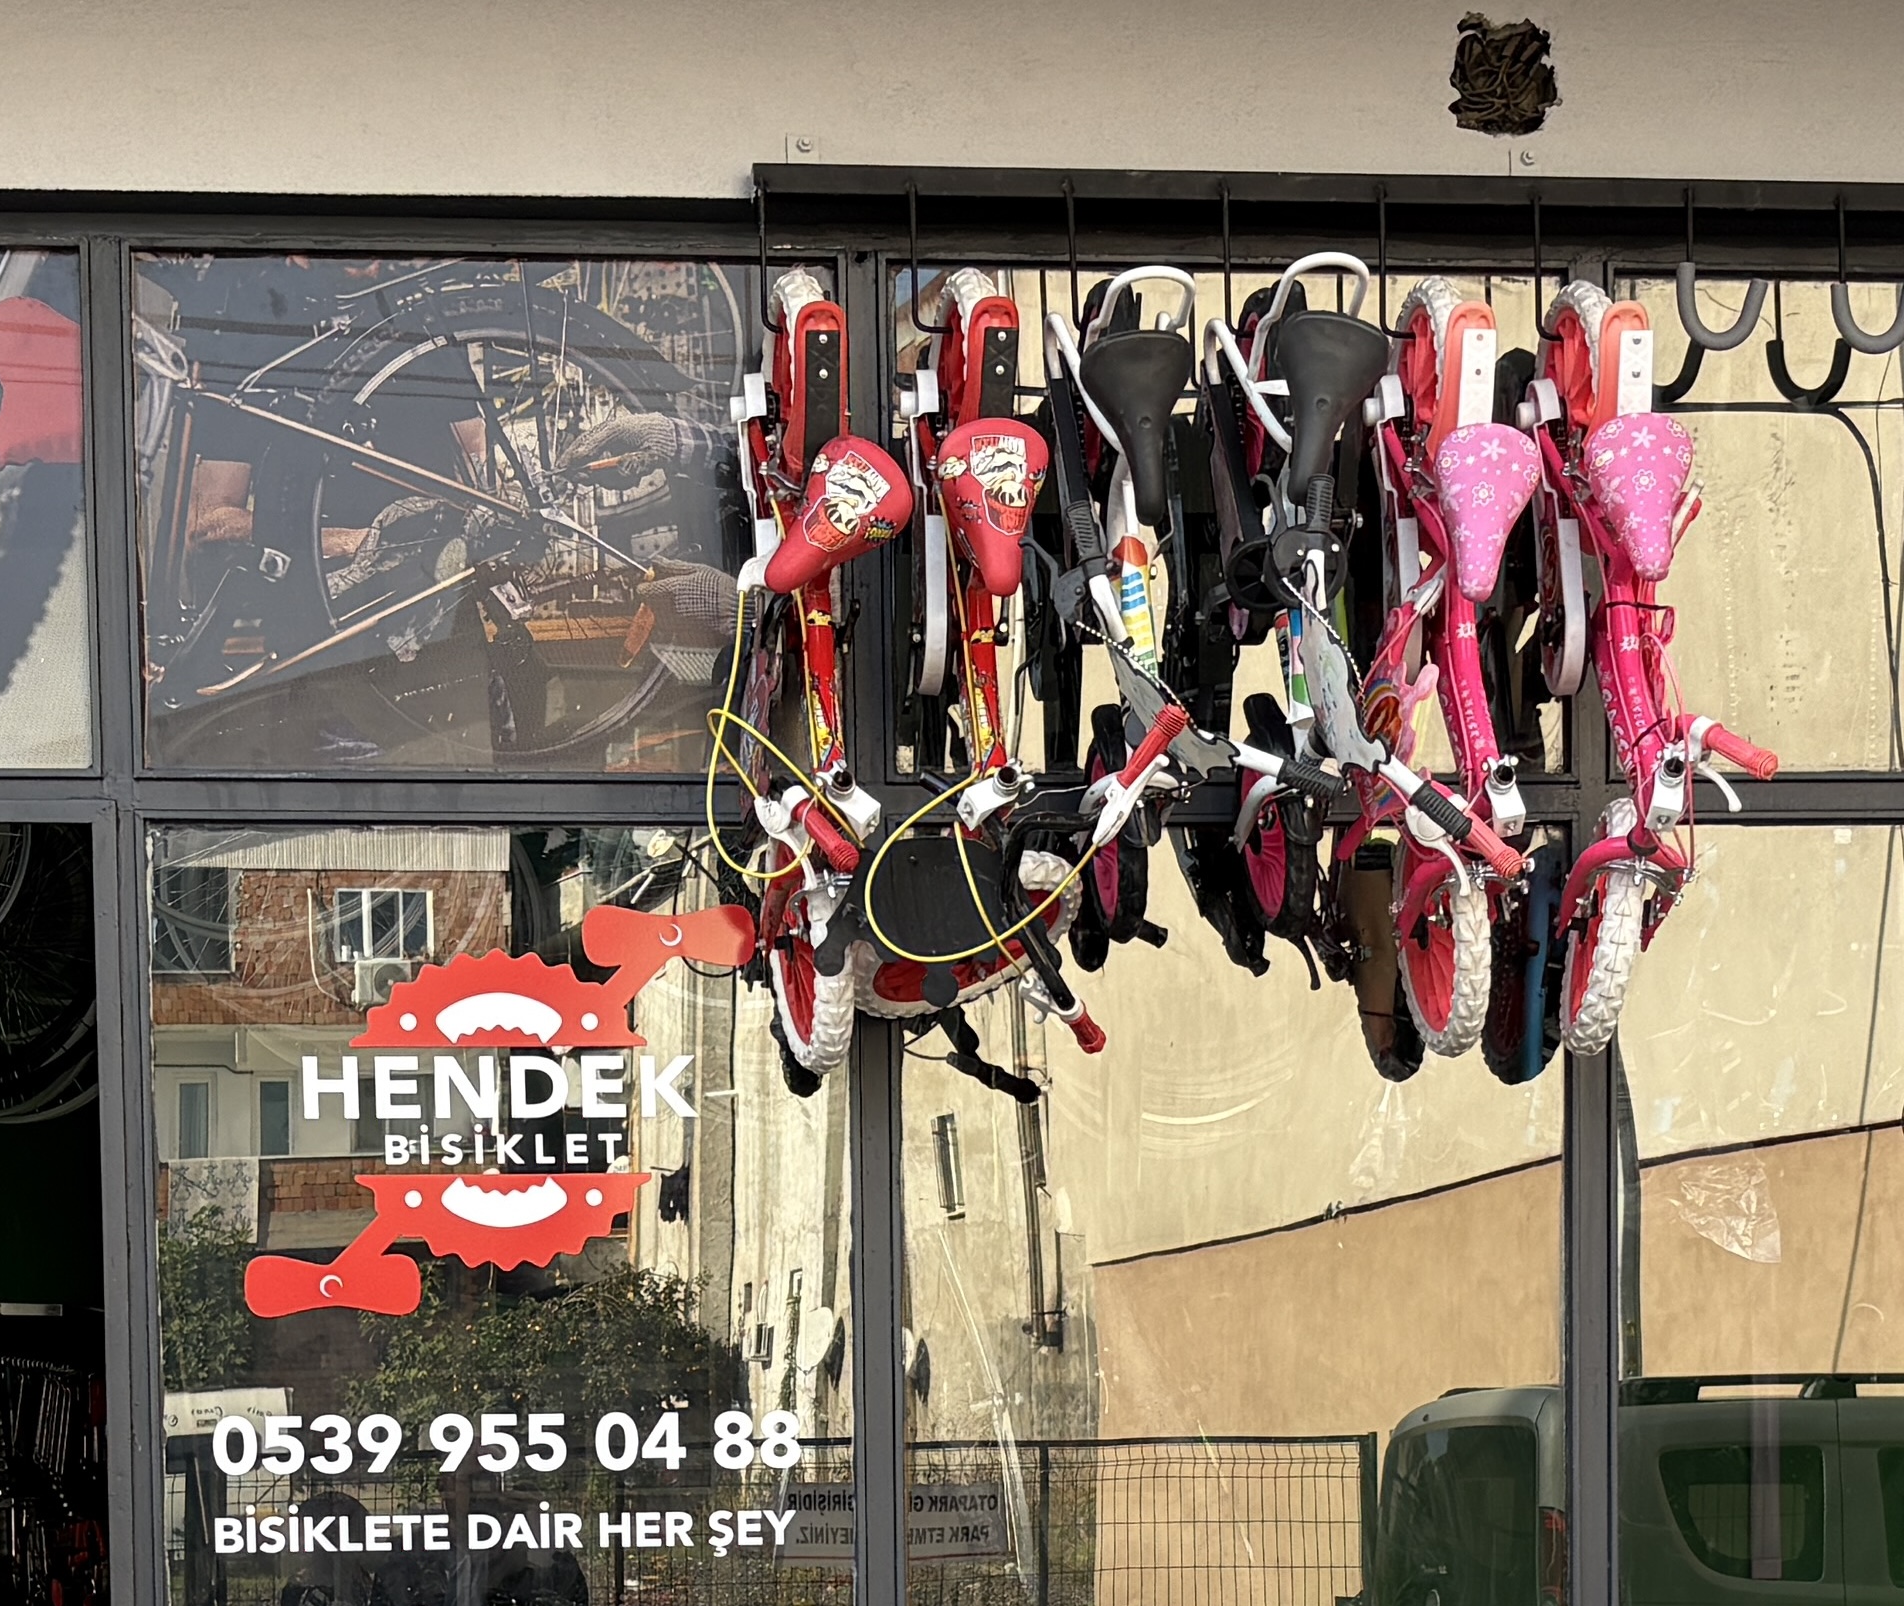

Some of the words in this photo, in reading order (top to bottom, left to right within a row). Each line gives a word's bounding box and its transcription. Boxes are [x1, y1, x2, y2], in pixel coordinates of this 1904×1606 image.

[302, 1055, 697, 1120] HENDEK
[385, 1124, 624, 1165] BİSİKLET
[213, 1414, 402, 1475] 0539
[430, 1412, 566, 1473] 955
[596, 1411, 687, 1470] 04
[713, 1410, 800, 1469] 88
[213, 1504, 451, 1553] BİSİKLETE
[468, 1503, 582, 1549] DAİR
[599, 1511, 694, 1548] HER
[708, 1509, 796, 1556] ŞEY
